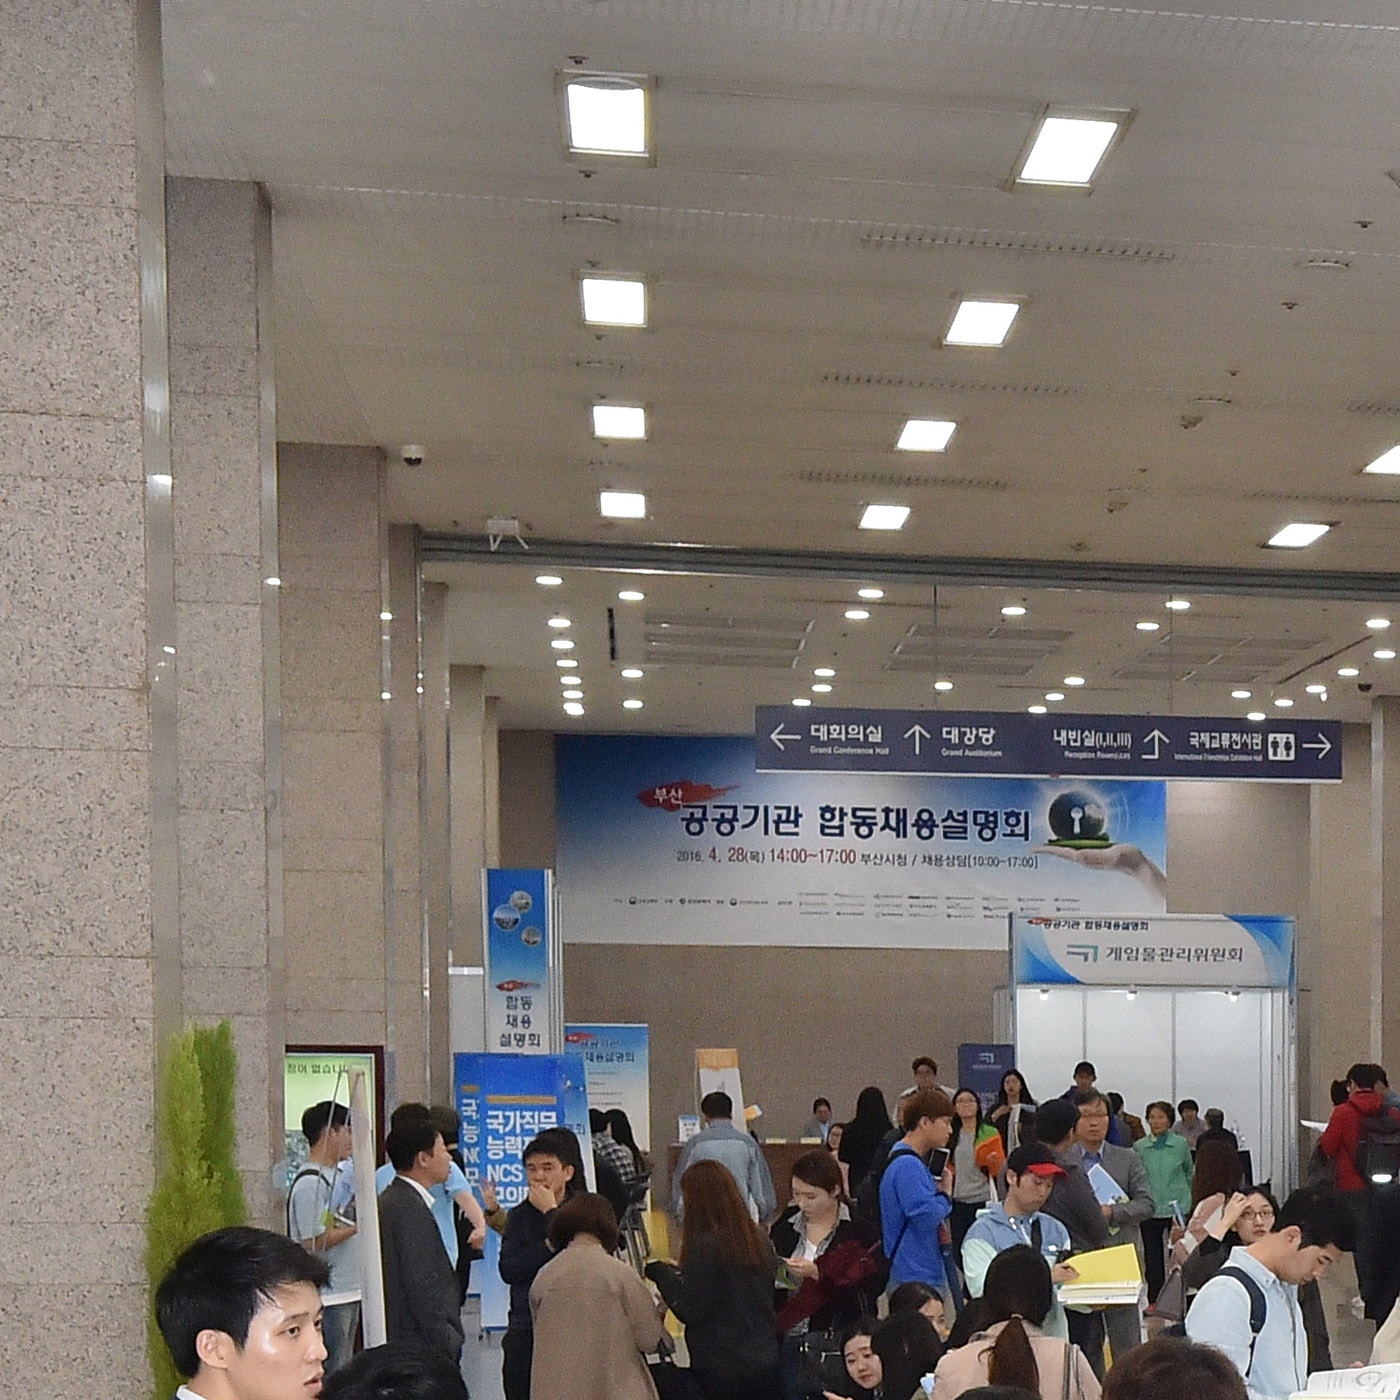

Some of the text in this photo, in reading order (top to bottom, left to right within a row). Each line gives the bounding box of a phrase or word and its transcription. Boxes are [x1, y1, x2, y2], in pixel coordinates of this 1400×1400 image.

[810, 723, 1263, 750] 대회의실 대강당 내빈실(I,II,III) 국제교류전시관
[652, 787, 1031, 842] 부산 공공기관 합동채용설명회
[769, 847, 857, 866] 14:00~17:00
[859, 851, 908, 868] 부산시청
[1105, 946, 1244, 964] 게임물관리위원회
[485, 1110, 558, 1134] 국가직무
[486, 1163, 523, 1183] NCS
